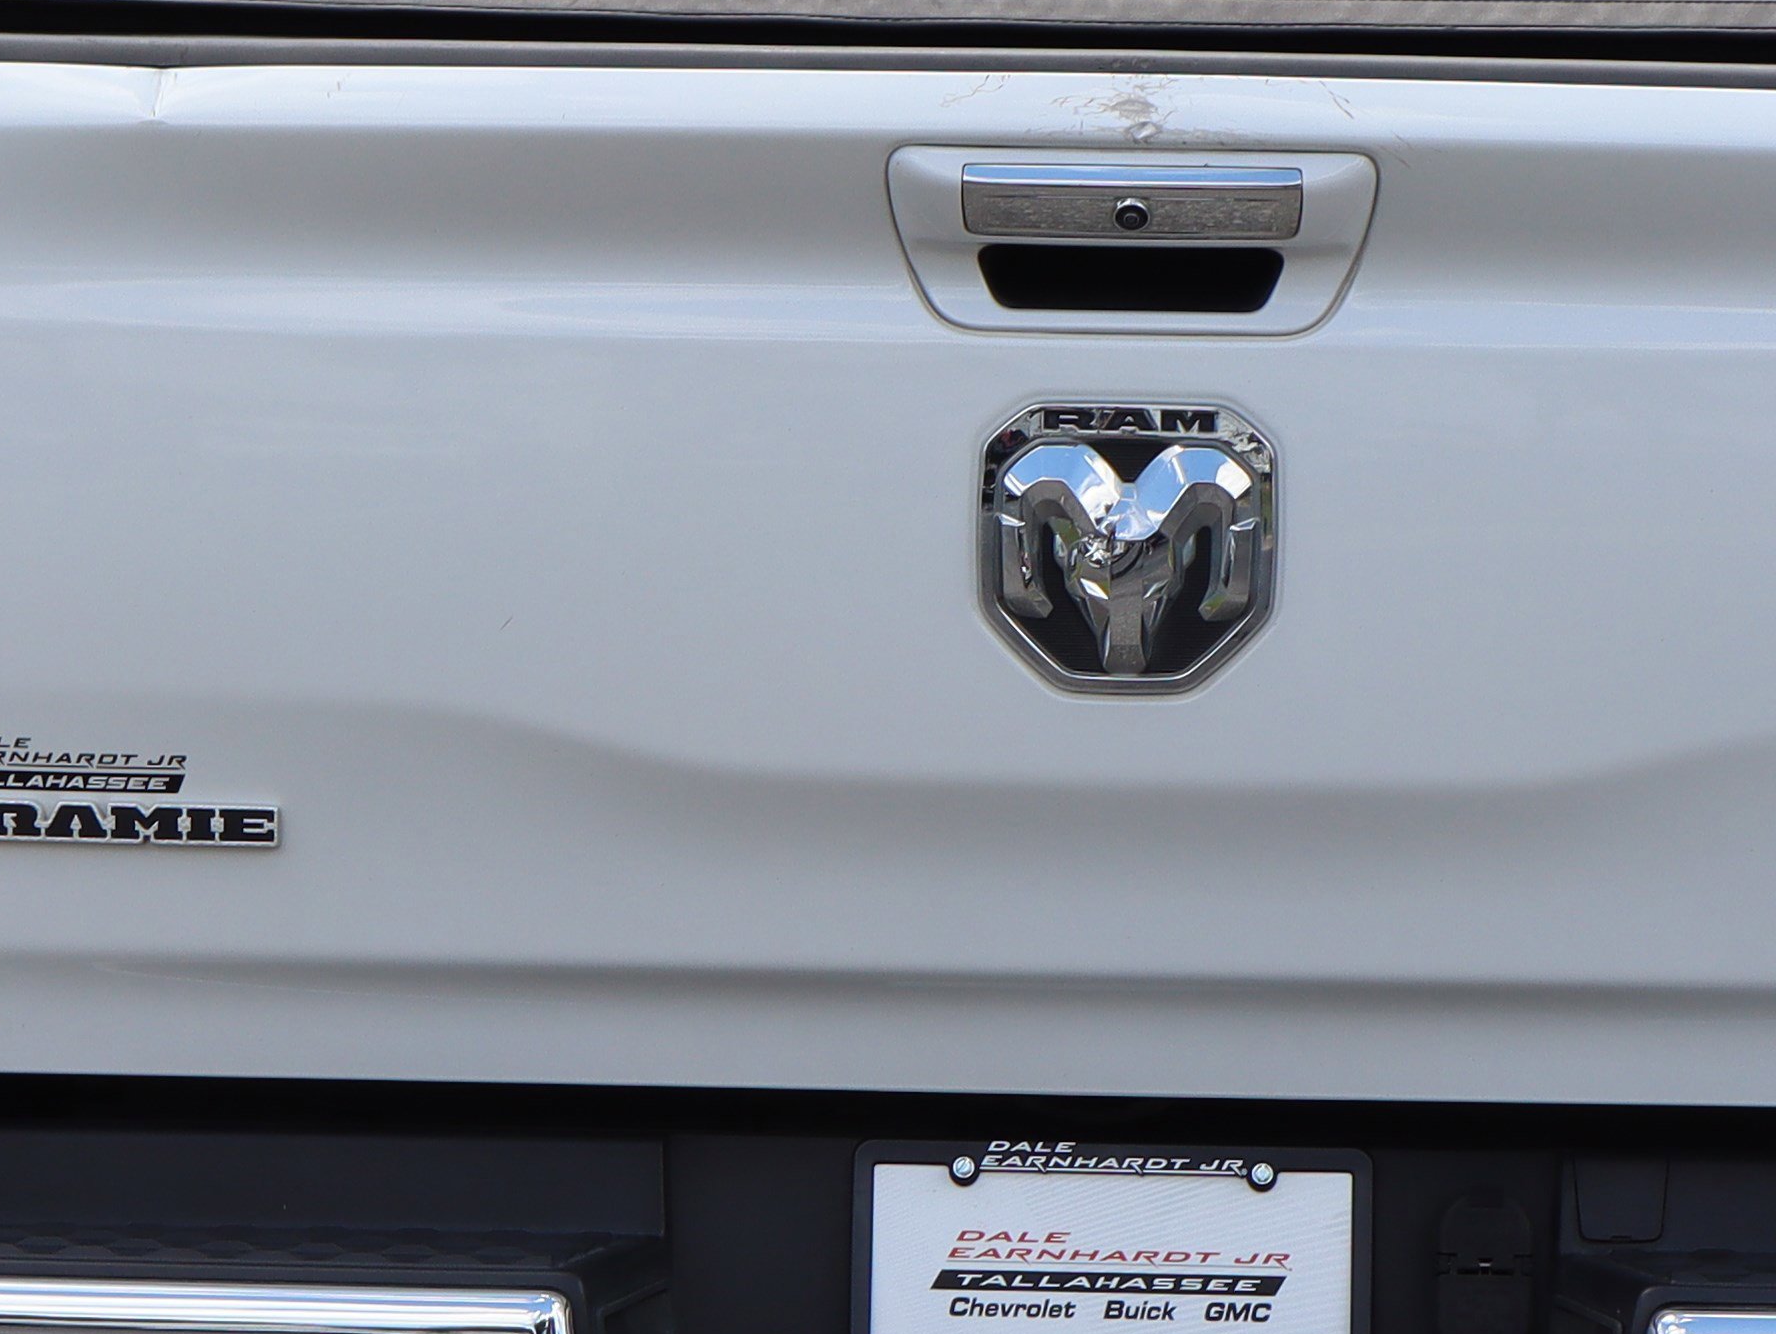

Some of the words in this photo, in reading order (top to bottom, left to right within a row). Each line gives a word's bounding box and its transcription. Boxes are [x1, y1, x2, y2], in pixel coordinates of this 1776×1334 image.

[1040, 408, 1219, 434] RAM
[145, 753, 188, 770] JR
[986, 1139, 1077, 1155] DALE
[979, 1154, 1191, 1176] EARNHARDT
[955, 1229, 1072, 1244] DALE
[946, 1246, 1221, 1267] EARNHARDT
[1232, 1252, 1292, 1271] JR
[955, 1273, 1262, 1293] TALLAHASSEE
[947, 1296, 1077, 1320] Chevrolet
[1103, 1300, 1177, 1322] Buick
[1203, 1302, 1273, 1324] GMC
